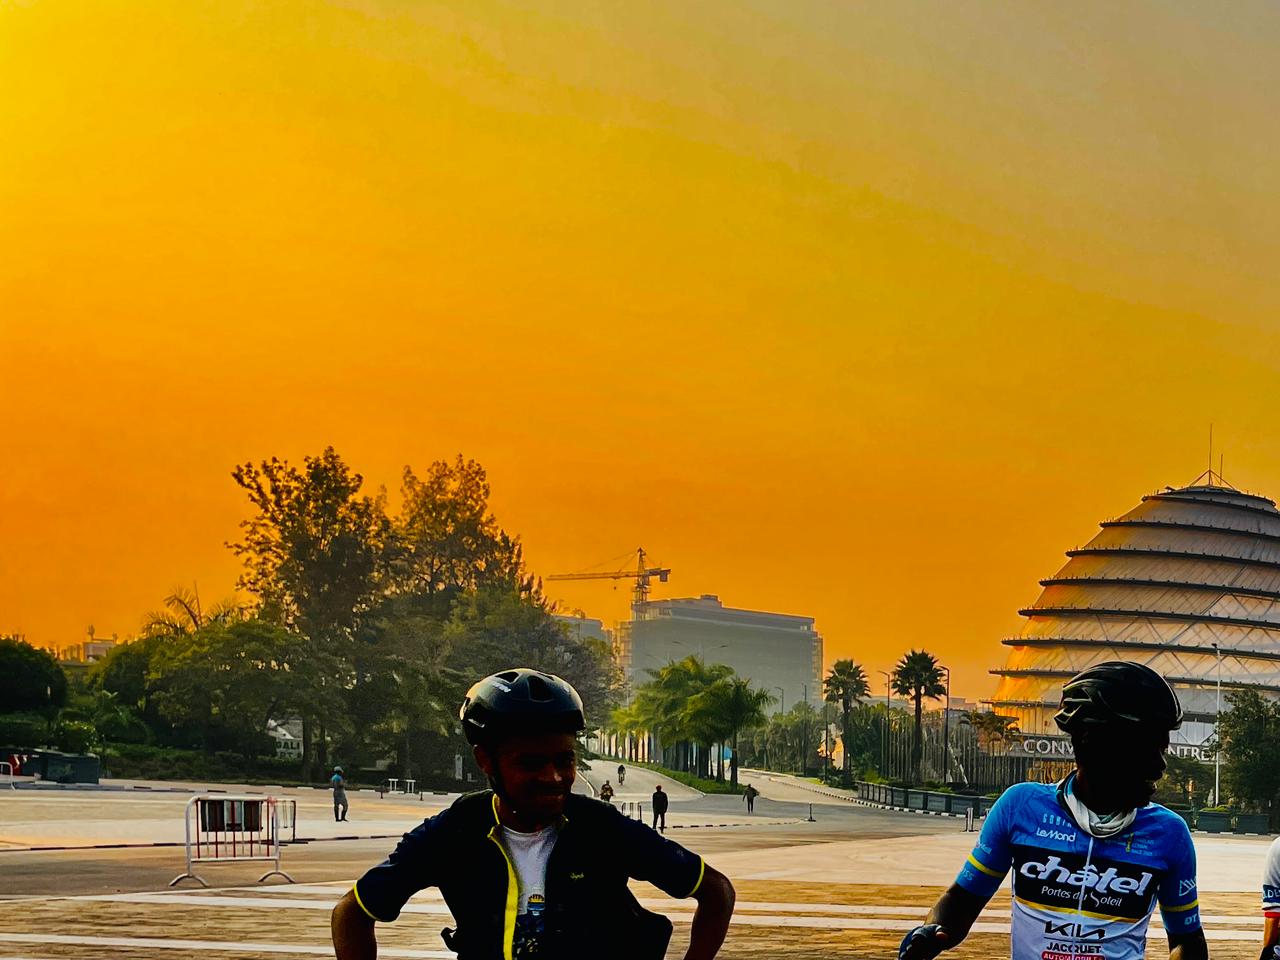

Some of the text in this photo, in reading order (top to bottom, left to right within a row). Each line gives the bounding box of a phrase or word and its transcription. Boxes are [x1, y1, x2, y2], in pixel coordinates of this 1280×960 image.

[1036, 827, 1076, 842] LeMond
[1020, 856, 1152, 896] châtel
[1041, 885, 1070, 899] Portes
[1090, 891, 1123, 908] Soleil
[1045, 920, 1106, 940] KIA
[1046, 942, 1102, 954] JACQUET
